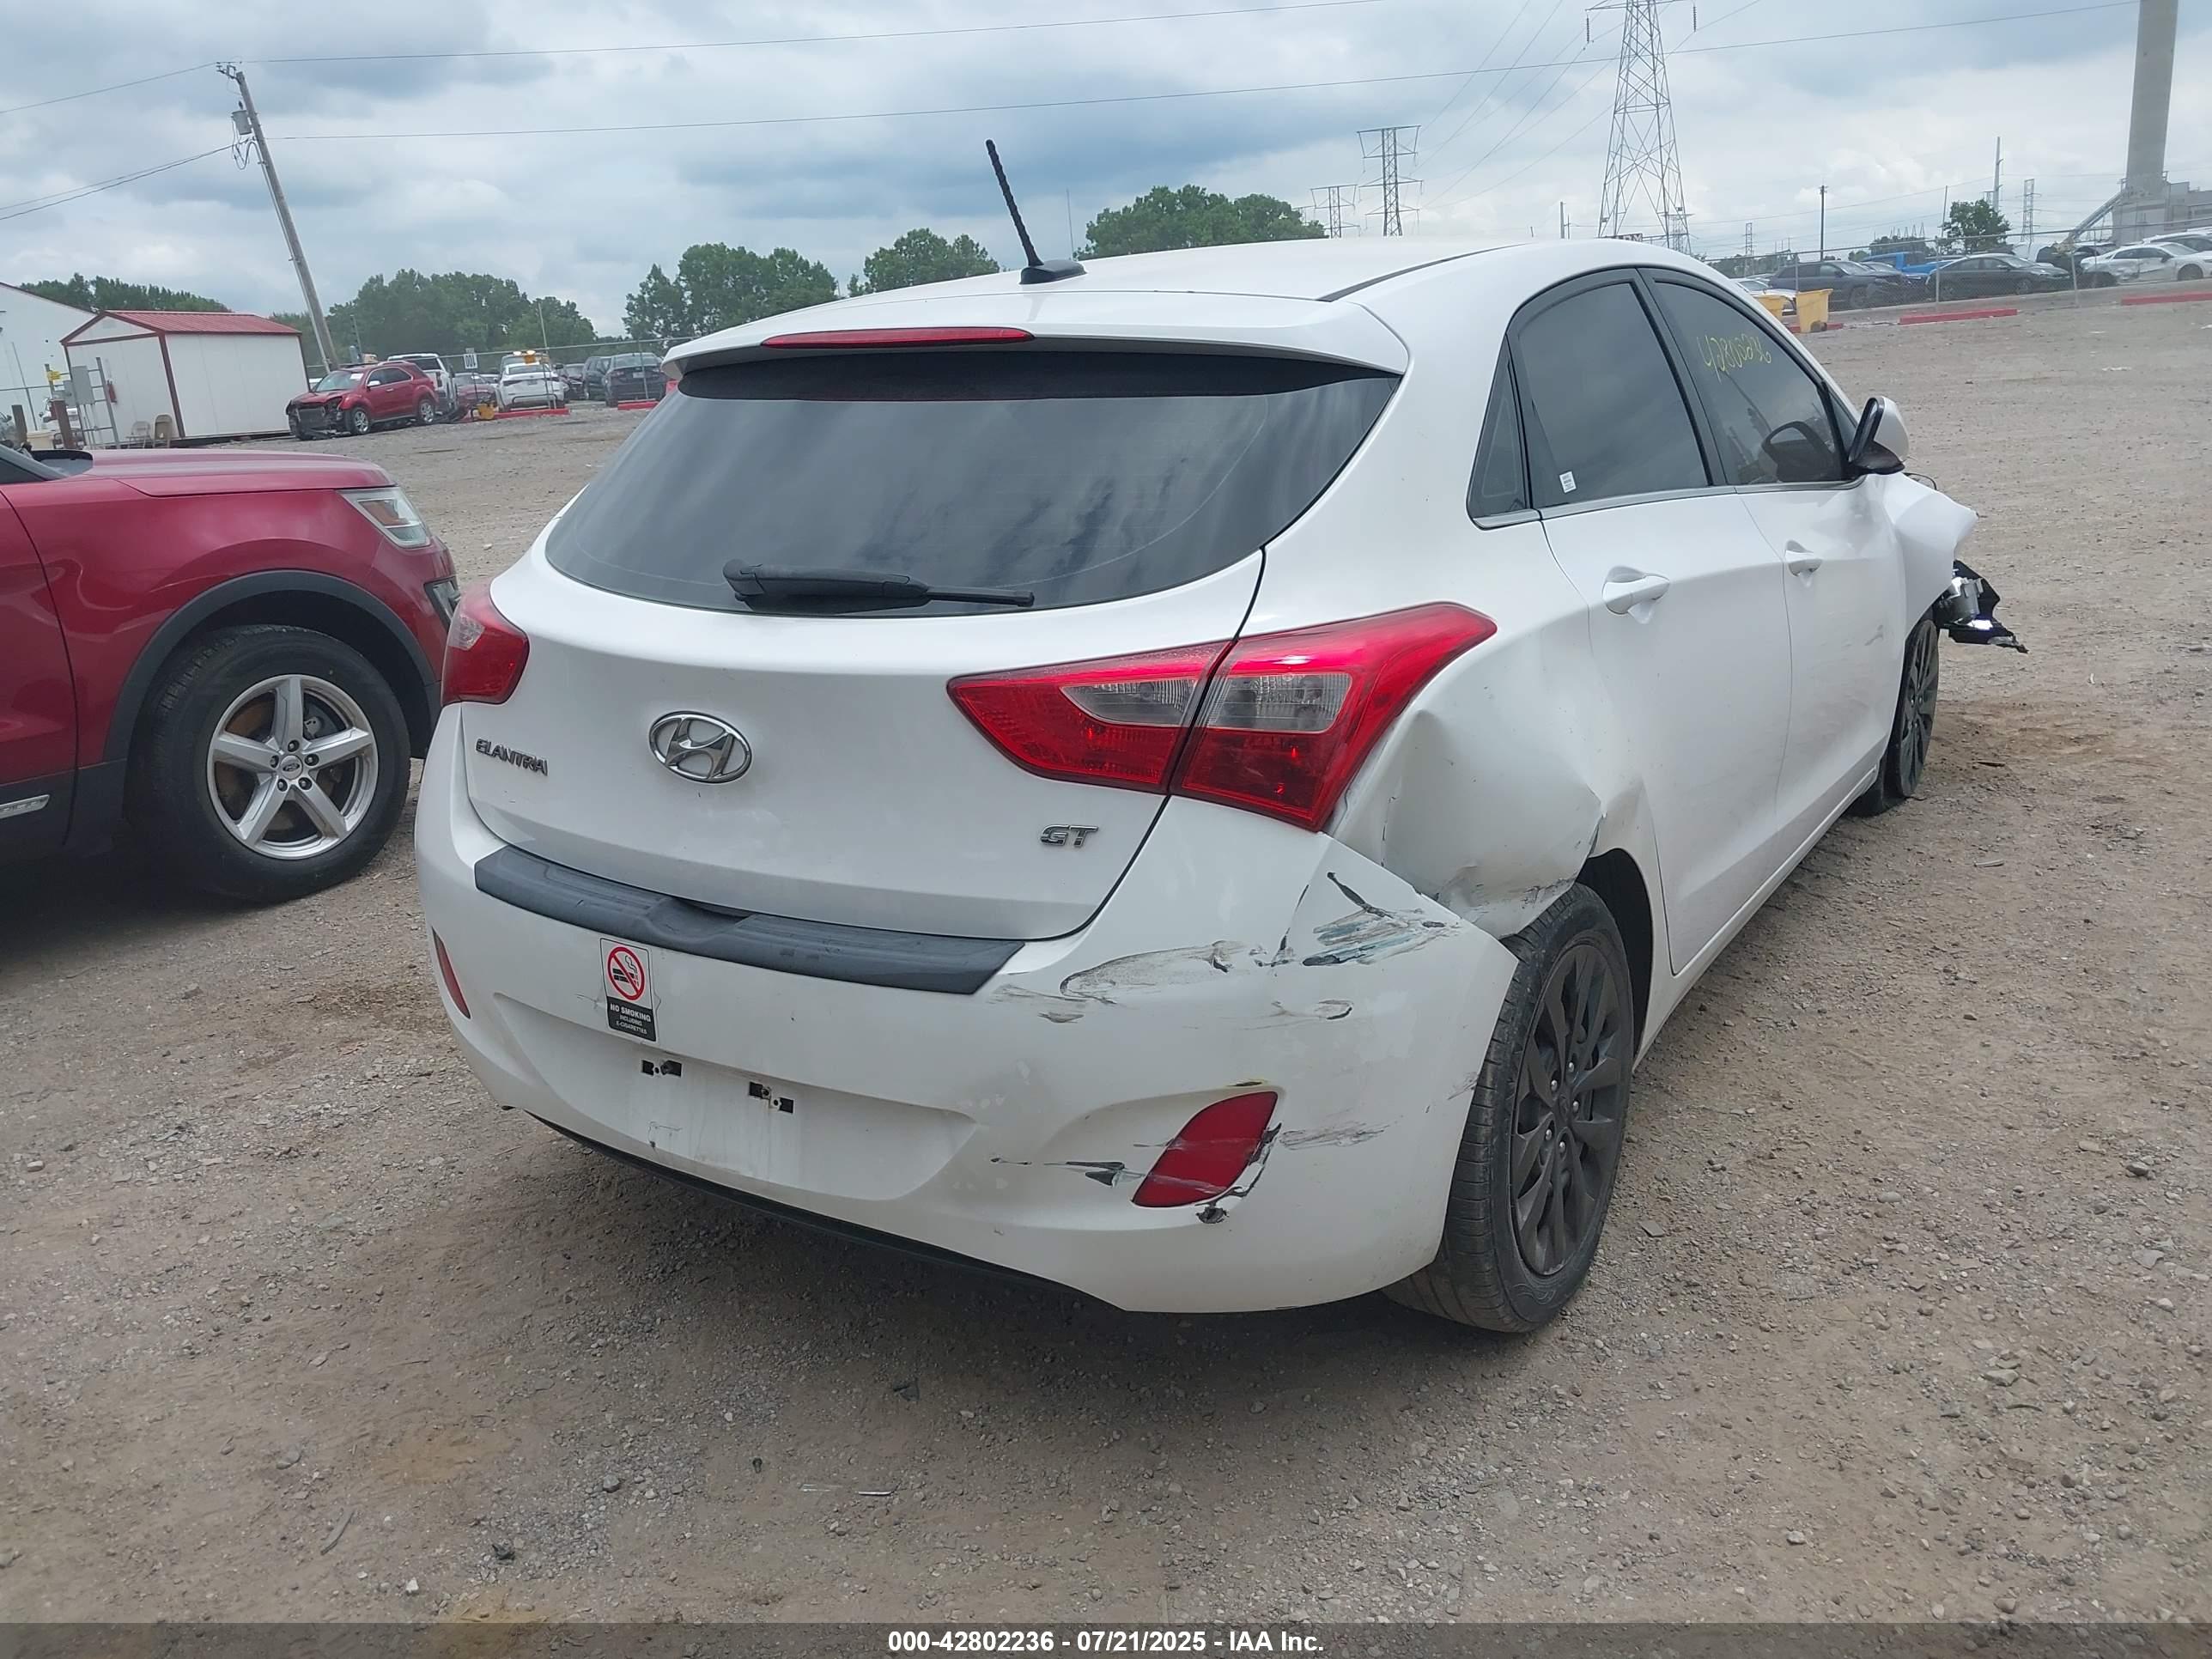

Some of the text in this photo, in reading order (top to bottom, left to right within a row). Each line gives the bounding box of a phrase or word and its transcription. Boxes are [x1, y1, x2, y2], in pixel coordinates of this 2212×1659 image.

[476, 738, 548, 776] ELANTRA
[1040, 824, 1099, 848] GT
[610, 1003, 652, 1023] NO SMOKING
